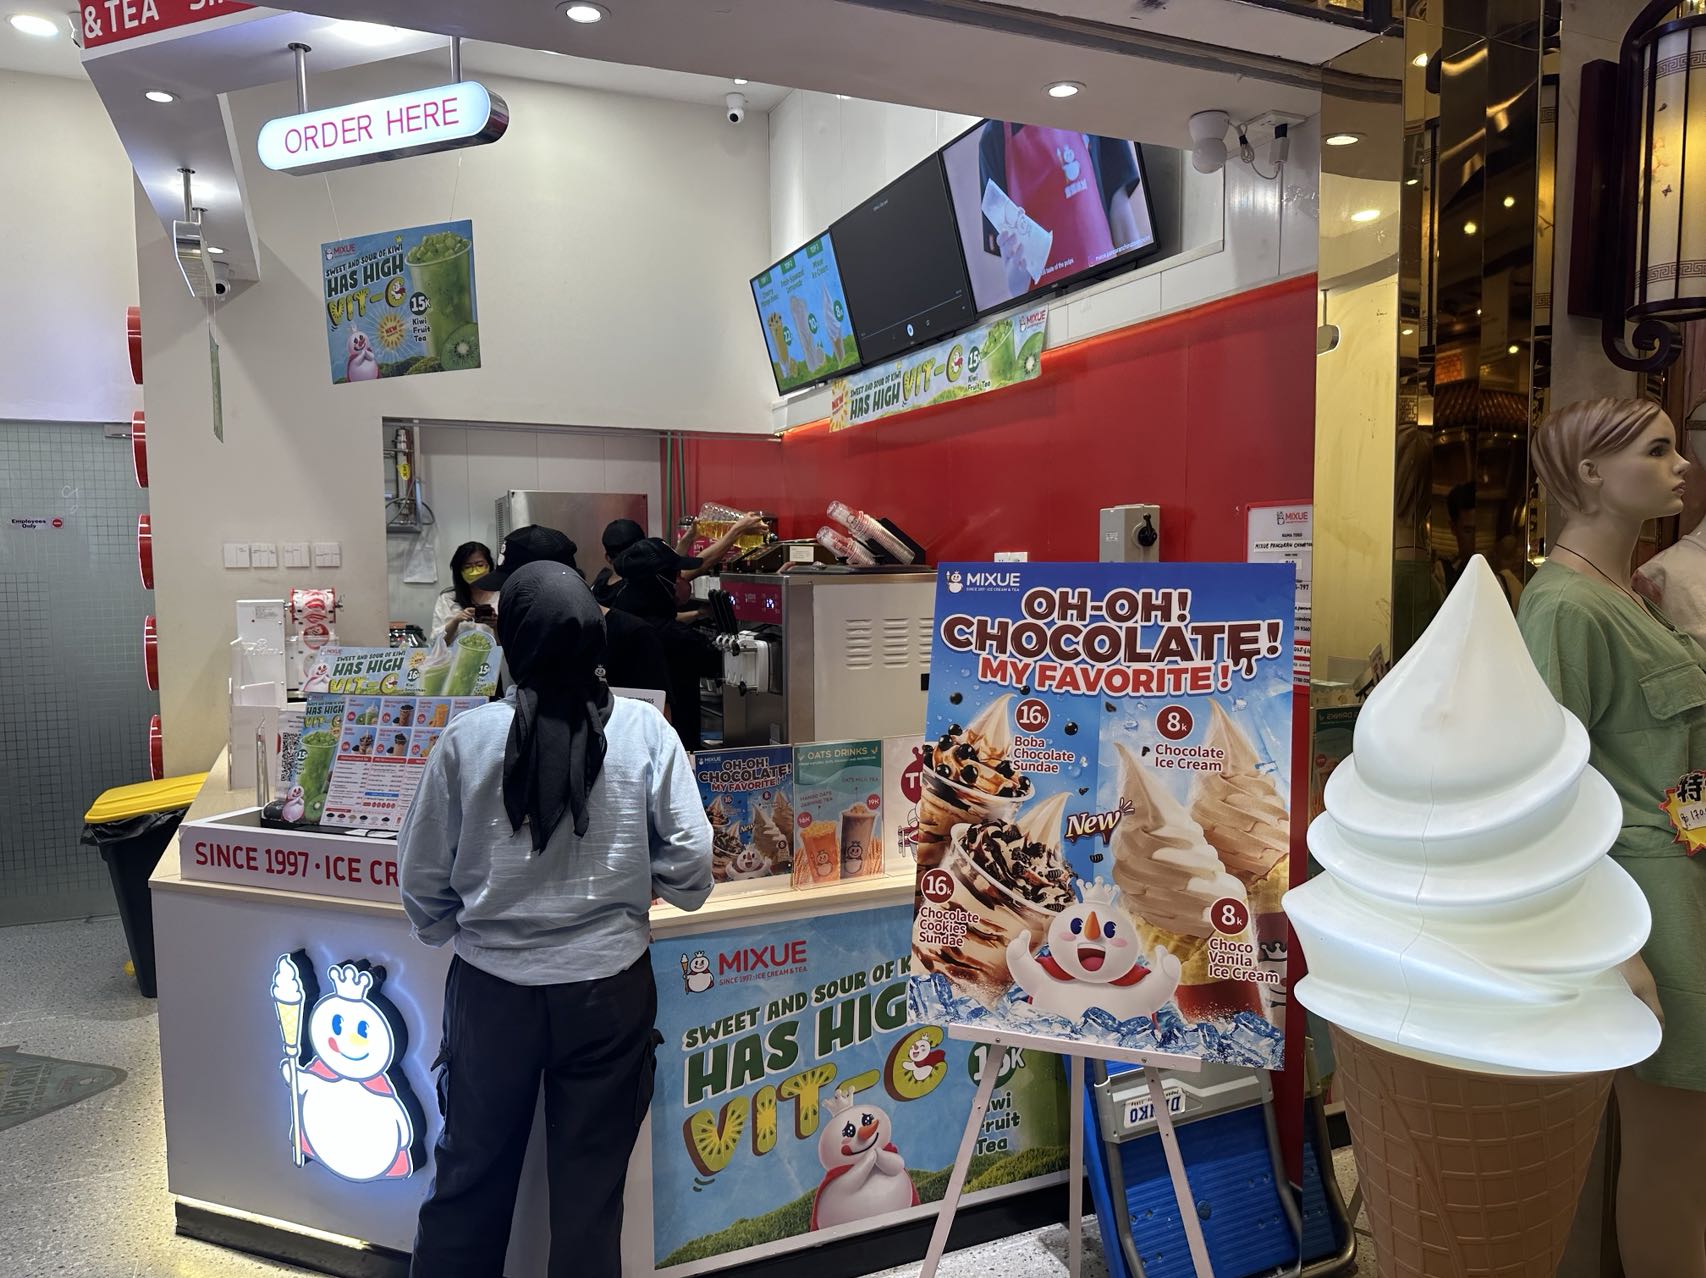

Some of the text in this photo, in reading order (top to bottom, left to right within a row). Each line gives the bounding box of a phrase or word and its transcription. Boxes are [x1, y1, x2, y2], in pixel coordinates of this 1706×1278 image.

[84, 0, 160, 39] & TEA
[284, 98, 460, 154] ORDER HERE
[334, 244, 355, 253] MIXUE
[326, 265, 346, 277] SWEET
[348, 259, 360, 269] AND
[360, 254, 377, 266] SOUR
[378, 250, 386, 258] OF
[387, 244, 403, 255] KIWI
[326, 253, 404, 298] HAS HIGH
[326, 276, 406, 326] VIT-C
[411, 296, 431, 312] 15K
[412, 318, 427, 326] Kiwi
[1026, 310, 1046, 324] MIXUE
[413, 326, 430, 334] Fruit
[902, 344, 964, 400] VIT-C
[968, 375, 978, 383] Kiwi
[850, 370, 901, 398] SWEET AND SOUR OF KIWI
[968, 380, 990, 391] Fruit Tea
[850, 392, 870, 420] HAS
[872, 382, 901, 412] HIGH
[1286, 512, 1308, 520] MIXUE
[966, 572, 1020, 586] MIXUE
[1024, 589, 1190, 622] OH-OH!
[942, 616, 1282, 670] CHOCOLATE!
[332, 657, 404, 676] HAS HIGH
[980, 655, 1031, 686] MY
[328, 672, 399, 694] VIT-C
[306, 705, 344, 715] HAS HIGH
[1014, 736, 1044, 747] Boba
[807, 747, 868, 760] OATS DRINKS
[1013, 748, 1074, 762] Chocolate
[1155, 744, 1224, 758] Chocolate
[722, 757, 769, 771] OH-OH!
[1013, 761, 1059, 773] Sundae
[1155, 757, 1222, 772] Ice Cream
[698, 764, 792, 783] CHOCOLATE!
[712, 782, 727, 792] MY
[1065, 810, 1120, 838] New
[194, 841, 399, 887] SINCE 1997 ICE CR
[920, 906, 979, 923] Chocolate
[920, 919, 966, 934] Cookies
[919, 932, 964, 947] Sundae
[1210, 938, 1253, 953] Choco
[718, 940, 807, 976] MIXUE
[1209, 951, 1252, 967] Vanila
[720, 977, 738, 985] SINCE
[756, 972, 765, 980] ICE
[767, 968, 788, 978] CREAM
[795, 966, 808, 974] TEA
[1210, 965, 1279, 983] Ice Cream
[685, 1006, 761, 1048] SWEET
[767, 992, 807, 1022] AND
[814, 972, 867, 1004] SOUR
[872, 960, 894, 984] OF
[688, 981, 908, 1105] HAS HIG
[682, 1025, 948, 1176] VIT-C
[980, 1112, 1021, 1132] ruit
[977, 1137, 1008, 1156] Tea
